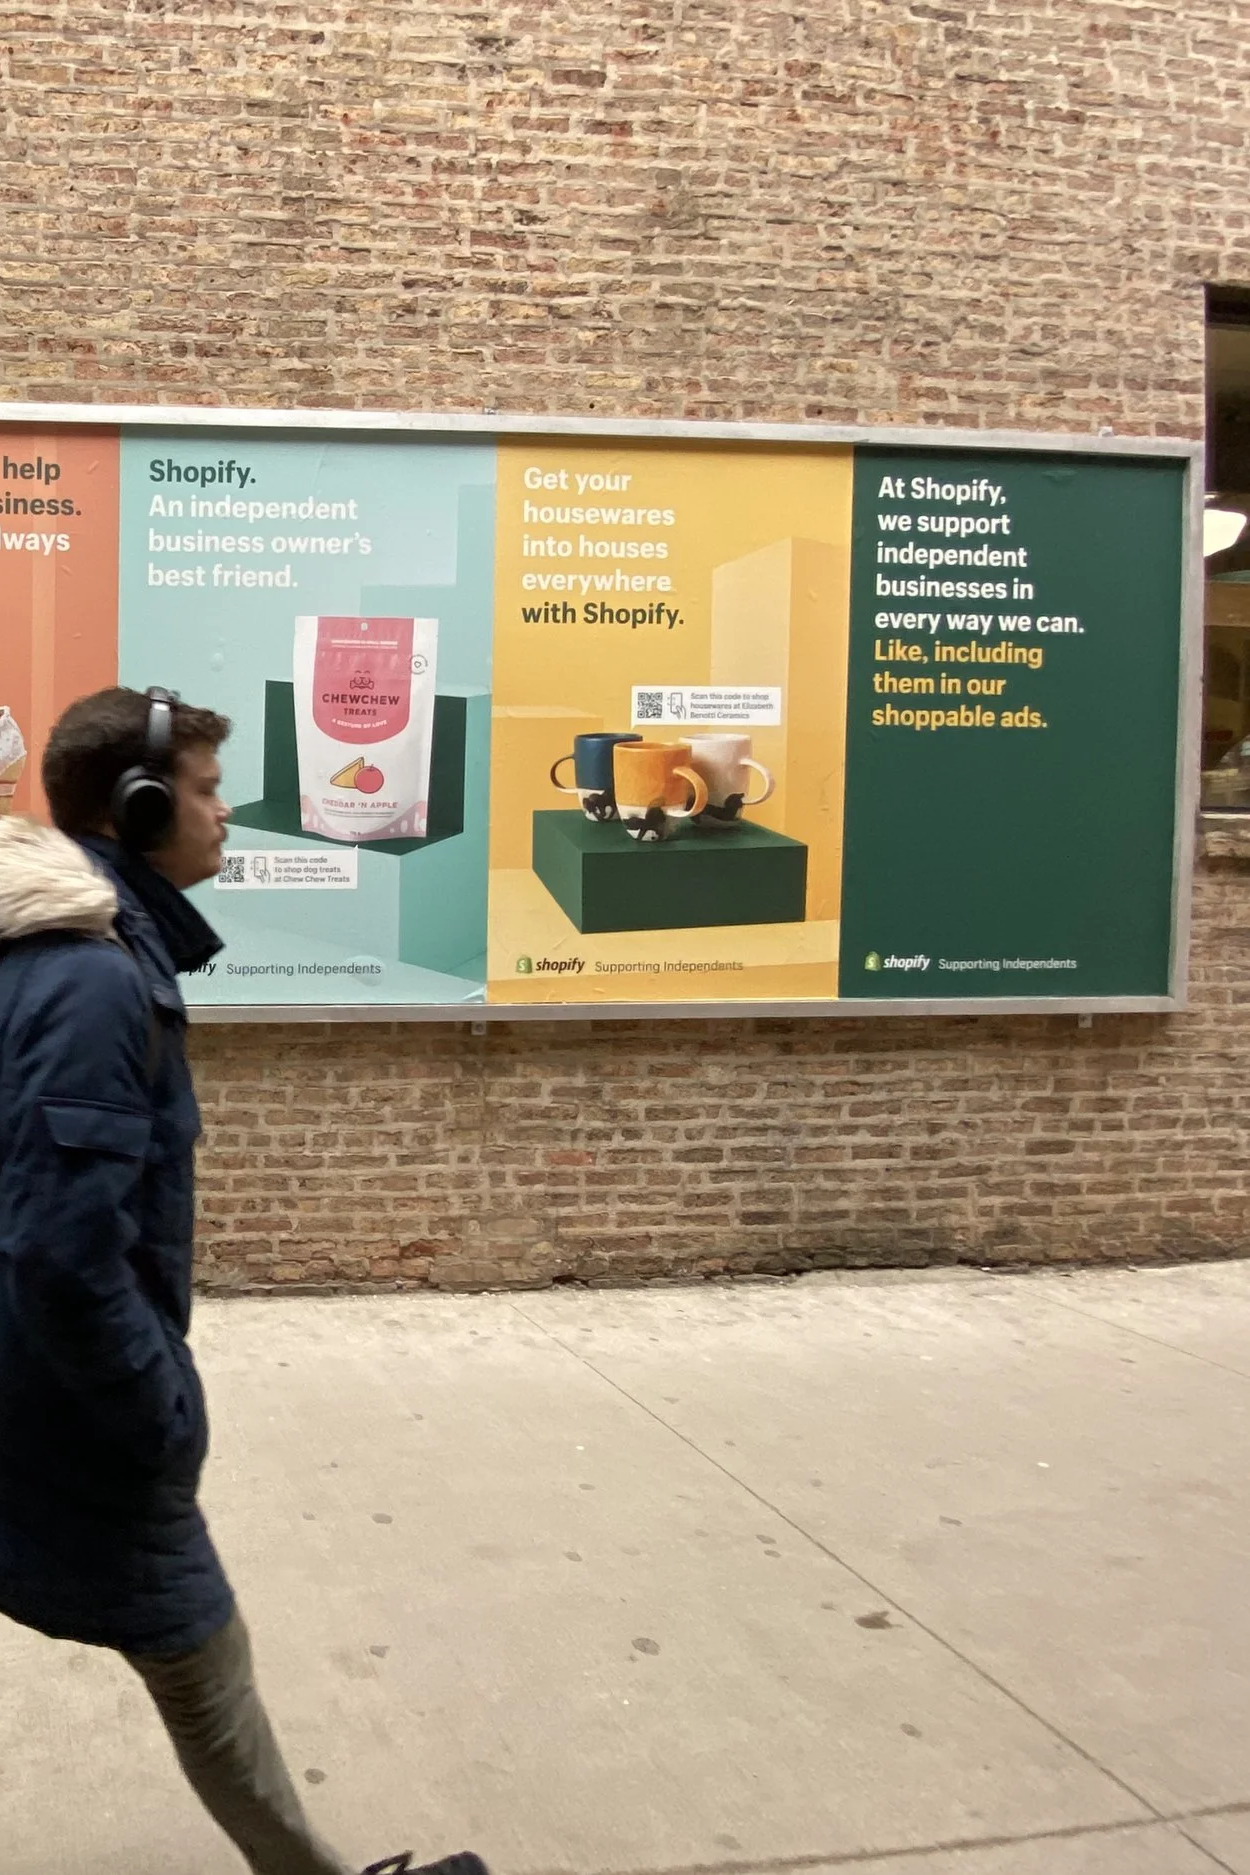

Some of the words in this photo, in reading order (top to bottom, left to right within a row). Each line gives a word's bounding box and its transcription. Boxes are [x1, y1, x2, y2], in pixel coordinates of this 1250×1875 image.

[3, 457, 61, 485] help
[149, 459, 256, 488] Shopify.
[524, 468, 568, 491] Get
[575, 472, 632, 494] your
[878, 477, 905, 498] At
[911, 477, 1007, 506] Shopify,
[149, 495, 183, 518] An
[190, 494, 358, 523] independent
[523, 501, 675, 526] housewares
[878, 514, 911, 531] we
[918, 514, 1010, 537] support
[148, 528, 264, 553] business
[522, 534, 572, 558] into
[579, 536, 668, 559] houses
[877, 541, 1028, 569] independent
[148, 563, 205, 587] best
[212, 564, 298, 588] friend.
[521, 569, 671, 595] everywhere
[876, 574, 1007, 599] businesses
[1013, 578, 1034, 599] in
[522, 602, 576, 624] with
[583, 602, 684, 629] Shopify.
[875, 611, 940, 633] every
[947, 614, 992, 634] way
[999, 614, 1031, 631] we
[1037, 612, 1084, 633] can.
[874, 640, 928, 664] Like,
[935, 641, 1043, 669] including
[873, 672, 934, 693] them
[941, 673, 961, 694] in
[967, 678, 1006, 695] our
[322, 694, 399, 705] CHEWCHEW
[872, 704, 995, 731] shoppable
[1001, 706, 1047, 728] ads.
[284, 866, 302, 874] shop
[303, 866, 318, 874] dog
[227, 964, 294, 976] Supporting
[298, 964, 381, 976] Independents
[536, 958, 585, 973] shopify
[595, 962, 660, 973] Supporting
[664, 961, 743, 972] Independents
[883, 955, 930, 971] shopify
[938, 959, 1000, 970] Supporting
[1003, 958, 1077, 970] Independents
